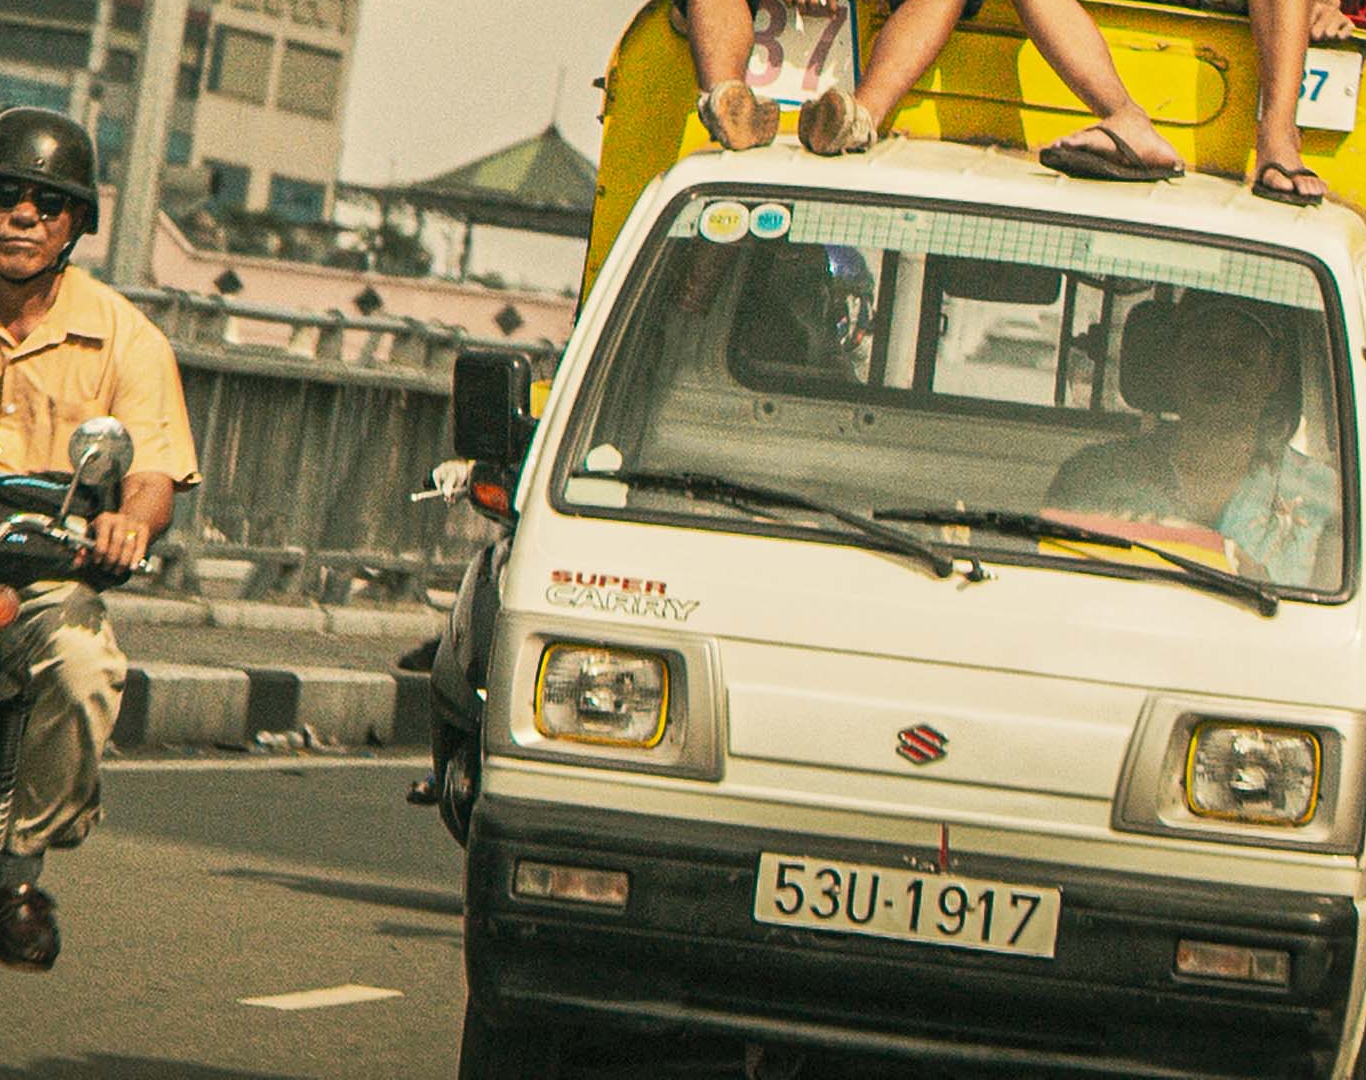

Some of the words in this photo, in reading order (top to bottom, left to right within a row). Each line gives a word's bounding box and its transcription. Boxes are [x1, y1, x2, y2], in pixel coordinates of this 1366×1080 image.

[1299, 68, 1329, 101] 7
[550, 570, 667, 596] SUPER
[545, 584, 701, 622] CARRY
[774, 861, 1042, 947] 53U-1917
